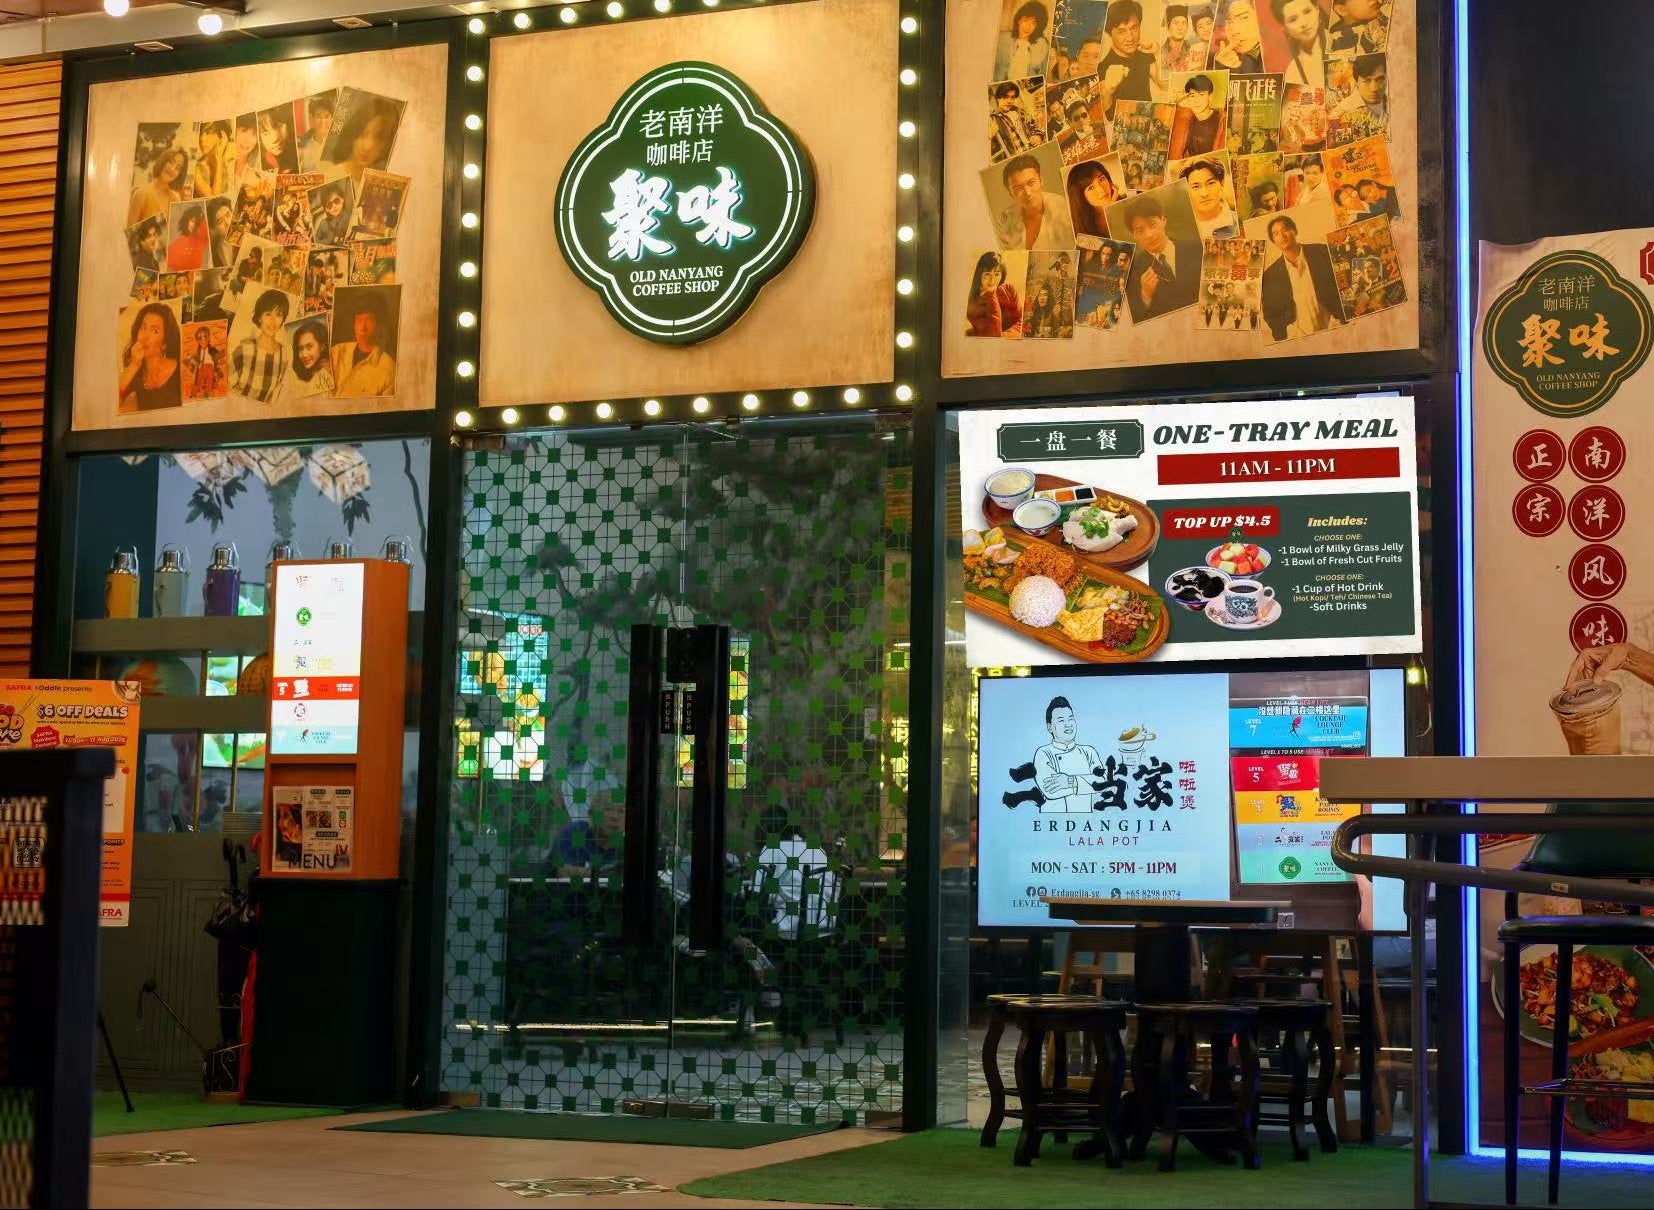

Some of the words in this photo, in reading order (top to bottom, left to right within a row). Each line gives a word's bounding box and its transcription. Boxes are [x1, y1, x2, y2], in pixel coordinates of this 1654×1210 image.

[1229, 79, 1277, 100] 阿飞正传
[639, 104, 723, 139] 老南洋
[646, 139, 714, 167] 咖啡店
[601, 166, 754, 261] 聚味
[630, 271, 657, 283] OLD
[659, 265, 723, 281] NANYANG
[633, 282, 682, 297] COFFEE
[684, 280, 719, 293] SHOP
[1538, 274, 1596, 295] 老南洋
[1543, 295, 1590, 312] 咖啡店
[1518, 312, 1620, 368] 聚味
[1536, 374, 1555, 382] OLD
[1557, 371, 1600, 381] NANYANG
[1539, 381, 1572, 391] COFFEE
[1574, 380, 1598, 389] SHOP
[1019, 428, 1118, 451] 一盘一餐
[1153, 420, 1311, 445] ONE-TRAY
[1314, 418, 1398, 440] MEAL
[1220, 461, 1270, 476] 11AM
[1287, 458, 1336, 474] 11PM
[1526, 443, 1552, 523] 正宗
[1173, 517, 1207, 529] TOP
[1210, 516, 1233, 528] UP
[1233, 515, 1271, 527] $4.5
[1307, 515, 1368, 527] Includes:
[1314, 534, 1344, 542] CHOOSE
[1582, 436, 1615, 647] 南洋风味
[1278, 546, 1288, 554] -1
[1289, 545, 1312, 554] Bowl
[1314, 545, 1325, 553] of
[1326, 544, 1351, 554] Milky
[1353, 544, 1380, 552] Grass
[1381, 543, 1404, 553] Jelly
[1280, 558, 1290, 566] -1
[1292, 557, 1315, 566] Bowl
[1317, 556, 1327, 565] of
[1328, 555, 1355, 565] Fresh
[1356, 555, 1373, 564] Cut
[1375, 554, 1403, 563] Fruits
[1292, 585, 1301, 594] -1
[1303, 584, 1322, 594] Cup
[1324, 584, 1335, 592] of
[1337, 583, 1356, 592] Hot
[1357, 582, 1384, 591] Drink
[1293, 594, 1309, 602] (Hot
[1348, 592, 1376, 600] Chinese
[1310, 602, 1334, 611] -Soft
[1336, 602, 1367, 611] Drinks
[37, 704, 56, 719] $6
[56, 704, 83, 718] OFF
[1002, 755, 1174, 811] 二当家
[1178, 760, 1196, 810] 啦啦煲
[1252, 773, 1260, 782] 5
[1032, 819, 1172, 833] ERDANGJIA
[1069, 836, 1104, 846] LALA
[1112, 836, 1140, 846] POT
[288, 853, 337, 869] MENU
[1031, 862, 1062, 874] MON
[1071, 862, 1097, 874] SAT
[1109, 862, 1136, 874] 5PM
[1146, 862, 1177, 874] 11PM
